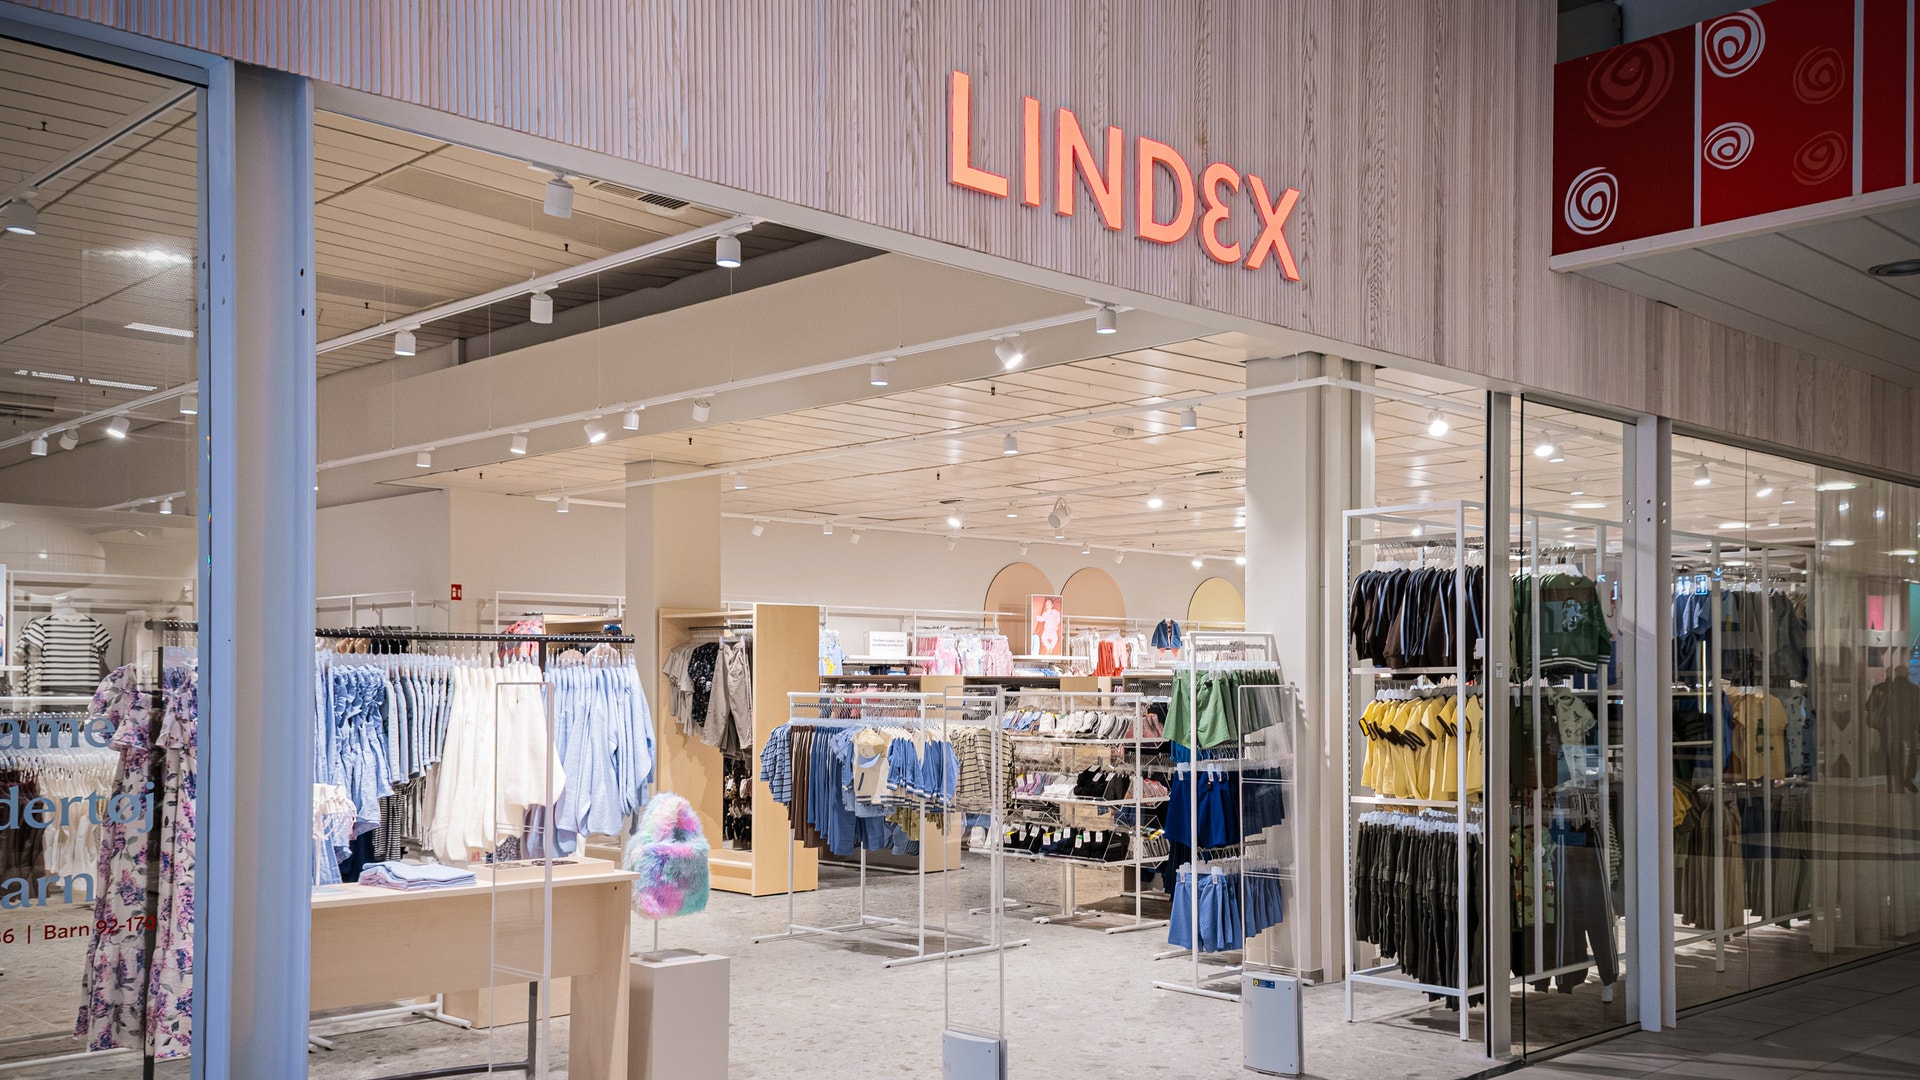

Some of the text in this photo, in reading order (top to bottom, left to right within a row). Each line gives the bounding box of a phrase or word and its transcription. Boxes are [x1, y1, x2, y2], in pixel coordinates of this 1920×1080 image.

[952, 70, 1300, 281] LINDEX
[0, 873, 95, 909] arn
[44, 925, 90, 940] Barn
[96, 915, 157, 935] 92-170
